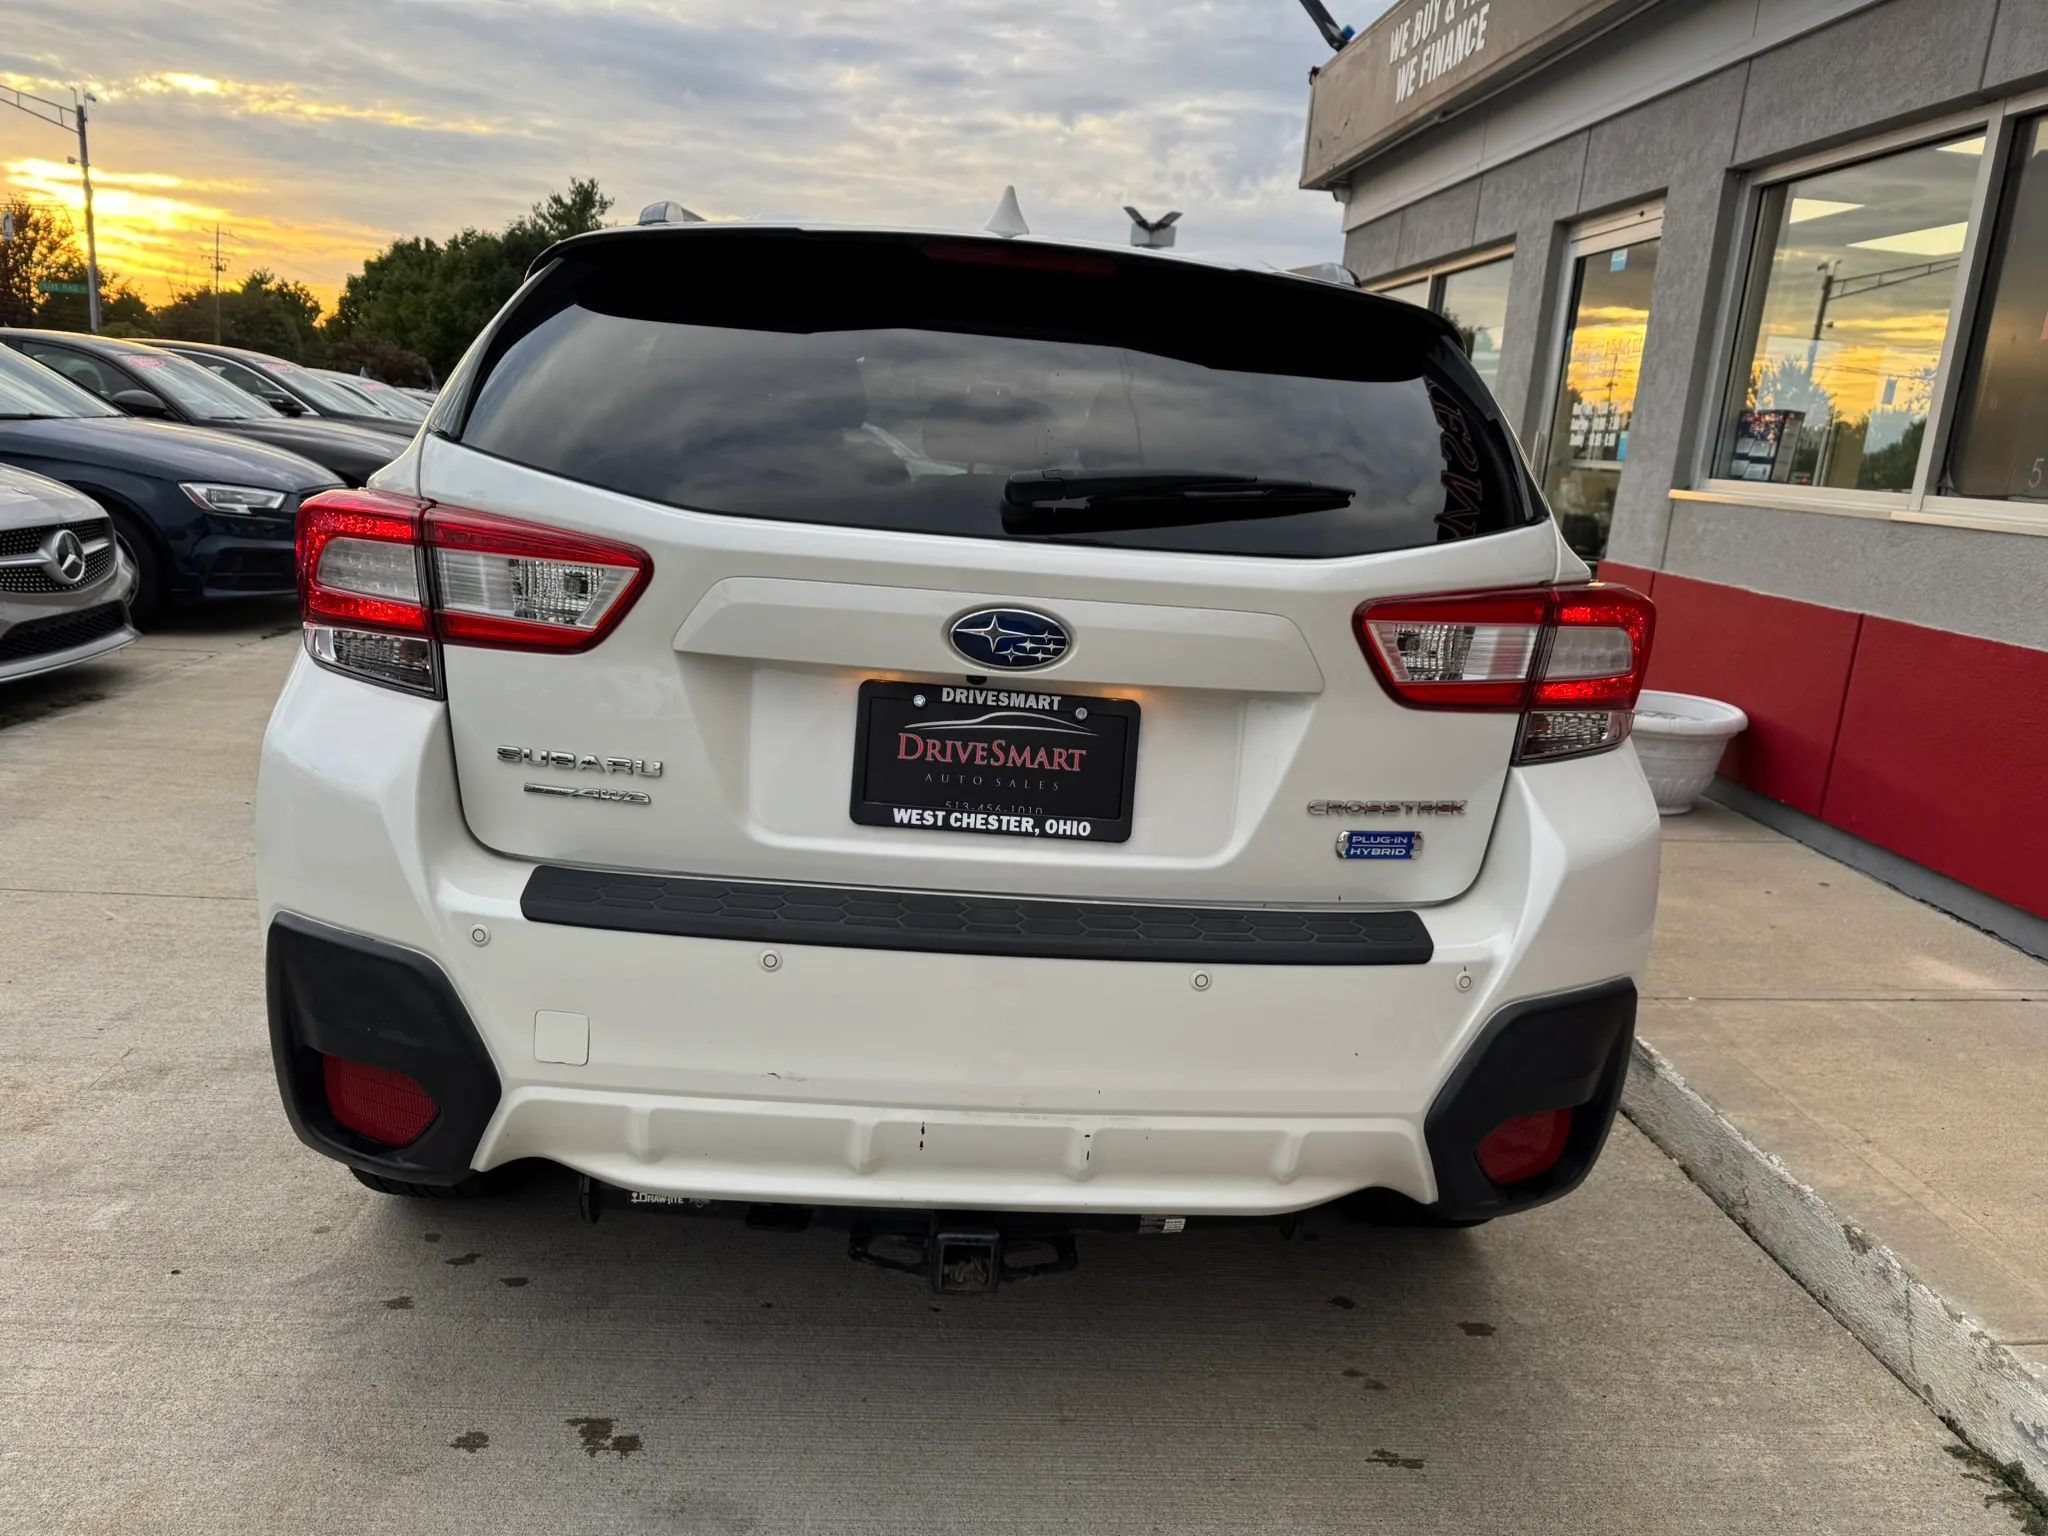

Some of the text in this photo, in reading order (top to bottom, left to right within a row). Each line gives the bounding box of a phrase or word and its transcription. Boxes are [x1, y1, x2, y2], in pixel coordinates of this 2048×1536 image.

[1389, 18, 1411, 65] WE
[1411, 0, 1441, 48] BUY
[1395, 3, 1490, 104] WE FINANCE
[941, 687, 1062, 711] DRIVESMART
[497, 744, 663, 778] SUBARU
[925, 773, 1060, 791] AUTO SALES
[570, 786, 652, 806] AWD
[1307, 799, 1469, 817] CROSSTREK
[893, 808, 1091, 836] WEST CHESTER, OHIO
[1352, 836, 1408, 844] PLUG-IN
[1350, 847, 1407, 857] HYBRID
